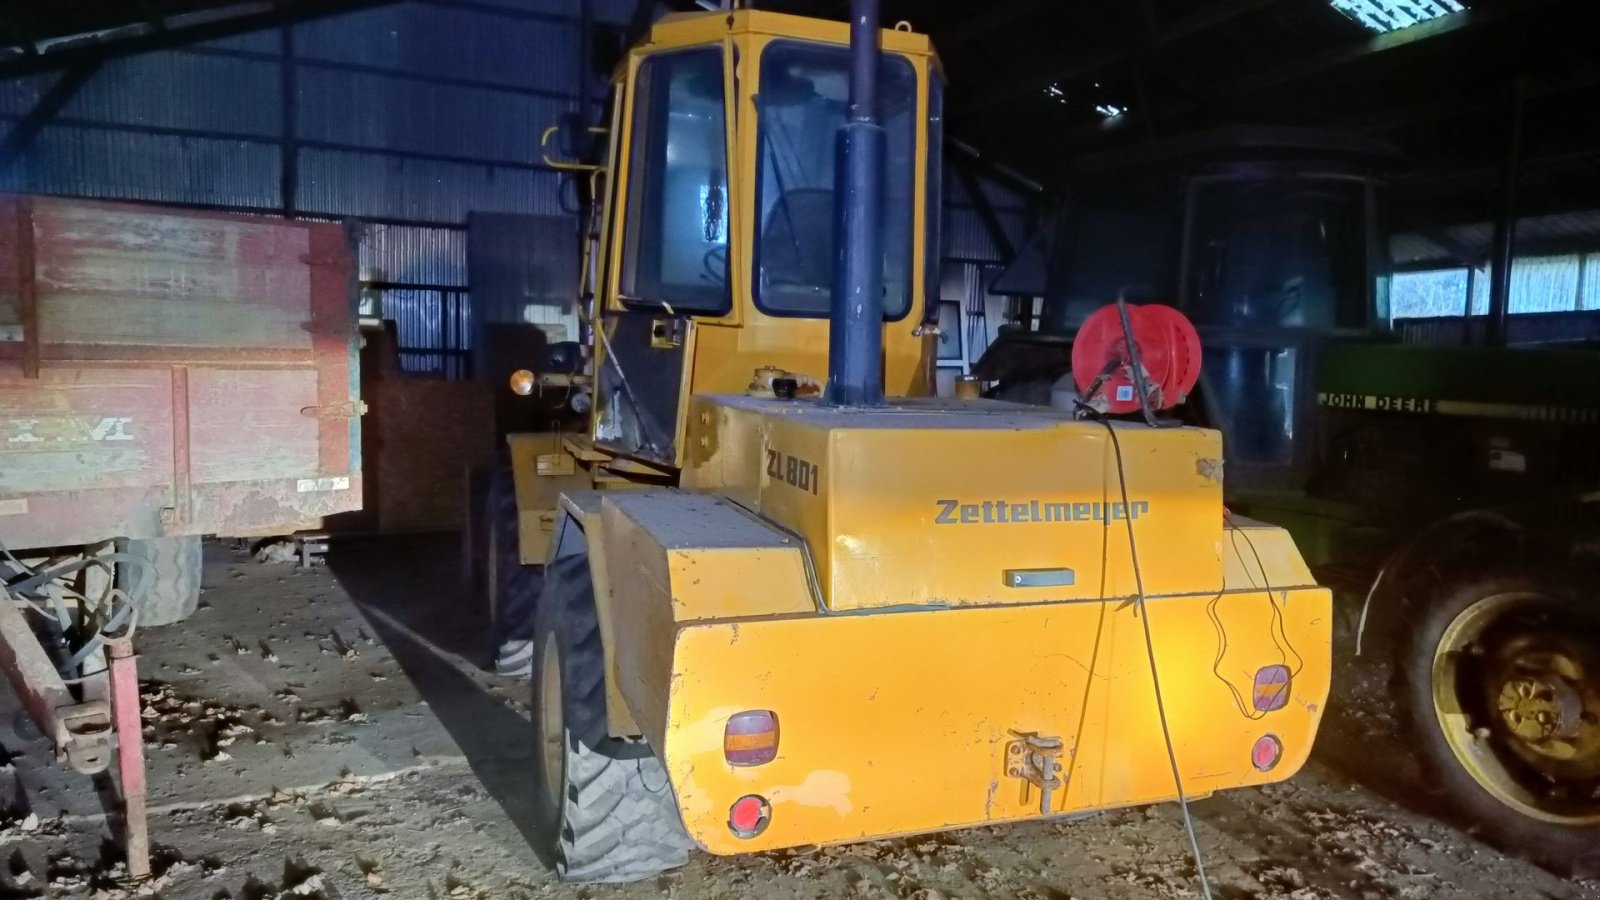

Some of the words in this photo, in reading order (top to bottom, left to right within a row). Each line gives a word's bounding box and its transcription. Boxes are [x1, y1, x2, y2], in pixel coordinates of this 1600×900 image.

[1320, 392, 1366, 409] JOHN
[1375, 395, 1438, 413] DEERE
[766, 448, 784, 481] ZL
[785, 455, 819, 496] 801
[935, 499, 1149, 526] Zettelmeyer
